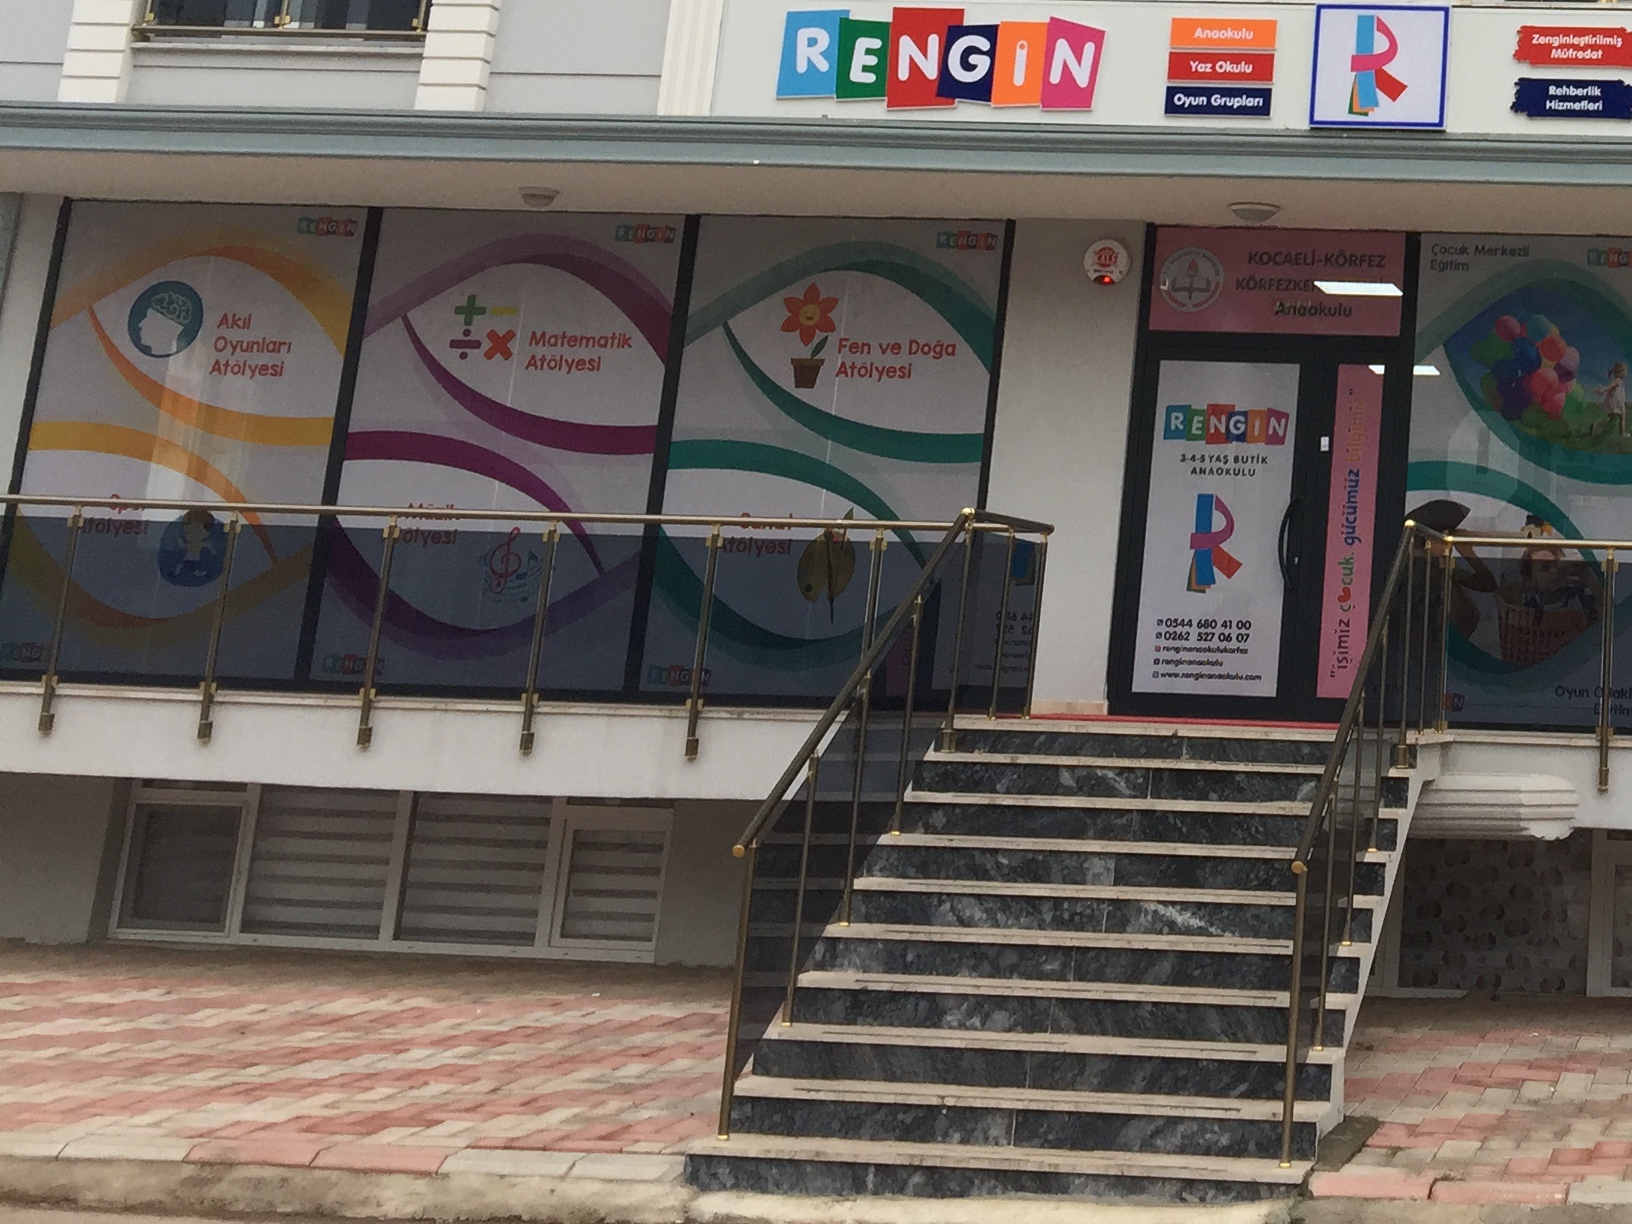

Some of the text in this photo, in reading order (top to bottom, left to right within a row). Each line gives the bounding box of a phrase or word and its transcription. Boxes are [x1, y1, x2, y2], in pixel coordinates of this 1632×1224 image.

[1194, 27, 1254, 40] Anaokulu
[1531, 33, 1623, 48] Zenginleştirilmiş
[1551, 47, 1603, 60] Müfredat
[1189, 60, 1253, 74] Yaz Okulu
[1548, 84, 1602, 97] Rehberlik
[1173, 93, 1264, 108] Oyun Grupları
[1546, 98, 1603, 112] Hizmetleri
[1430, 243, 1530, 257] Çocuk Merkezli
[1430, 258, 1470, 273] Eğitim
[1275, 301, 1353, 317] Anaokulu
[216, 312, 252, 330] Akıl
[213, 335, 292, 356] Oyunları
[528, 330, 633, 349] Matematik
[837, 337, 957, 360] Fen ve Doğa
[209, 359, 285, 380] Atölyesi
[524, 353, 602, 374] Atölyesi
[835, 361, 913, 382] Atölyesi
[1232, 453, 1269, 465] BUTİK
[1190, 466, 1257, 477] ANAOKULU
[1164, 617, 1252, 631] 0544 680 41 00
[1163, 630, 1250, 644] 0262 527 06 07
[1554, 685, 1590, 700] Oyun
